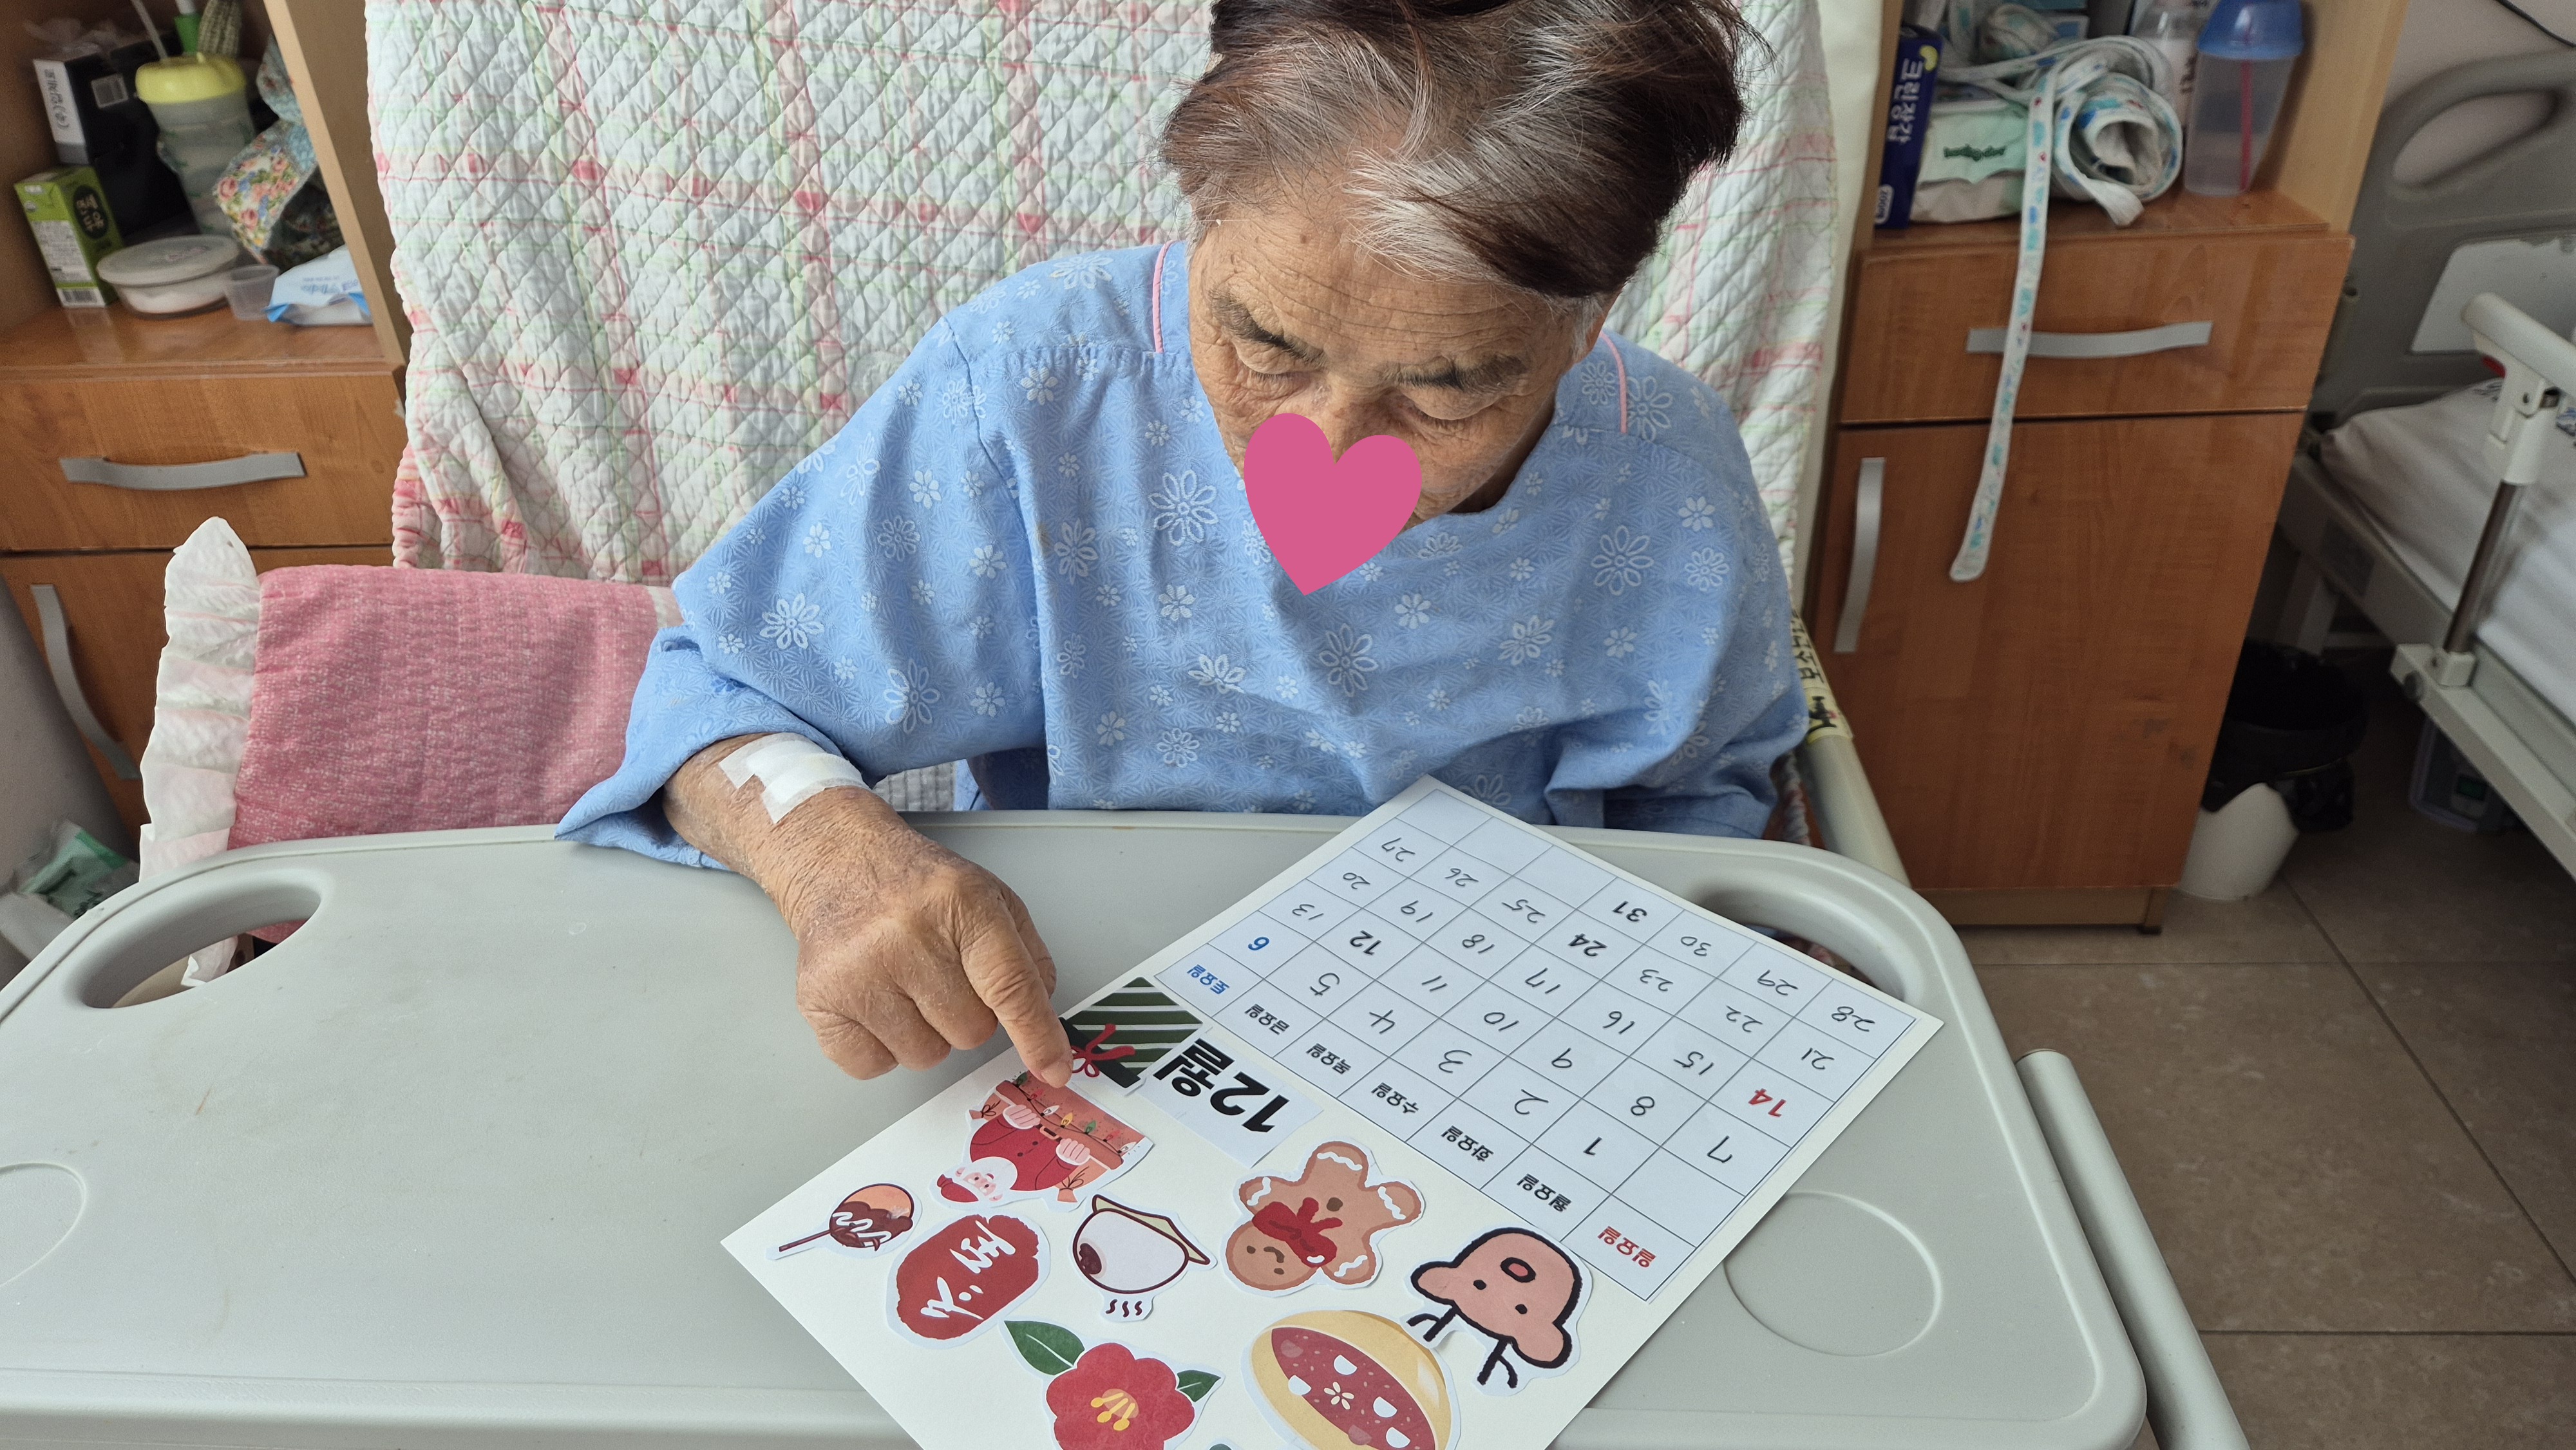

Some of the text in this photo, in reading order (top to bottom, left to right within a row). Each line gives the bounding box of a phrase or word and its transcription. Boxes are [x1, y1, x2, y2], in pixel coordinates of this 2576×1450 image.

[1888, 58, 1923, 144] 크린장갑
[1248, 937, 1602, 1155] 1 2 3 4 5 6
[1292, 904, 1732, 1163] 7 8 9 10 11 12 13
[1343, 872, 1786, 1117] 14 15 16 17 18 19 20
[1381, 838, 1834, 1069] 21 22 23 24 25 26 27
[1613, 901, 1875, 1032] 28 29 30 31
[1153, 1038, 1290, 1133] 12월
[1187, 965, 1656, 1268] 일요일 월요일 화요일 수요일 목요일 금요일 토요일
